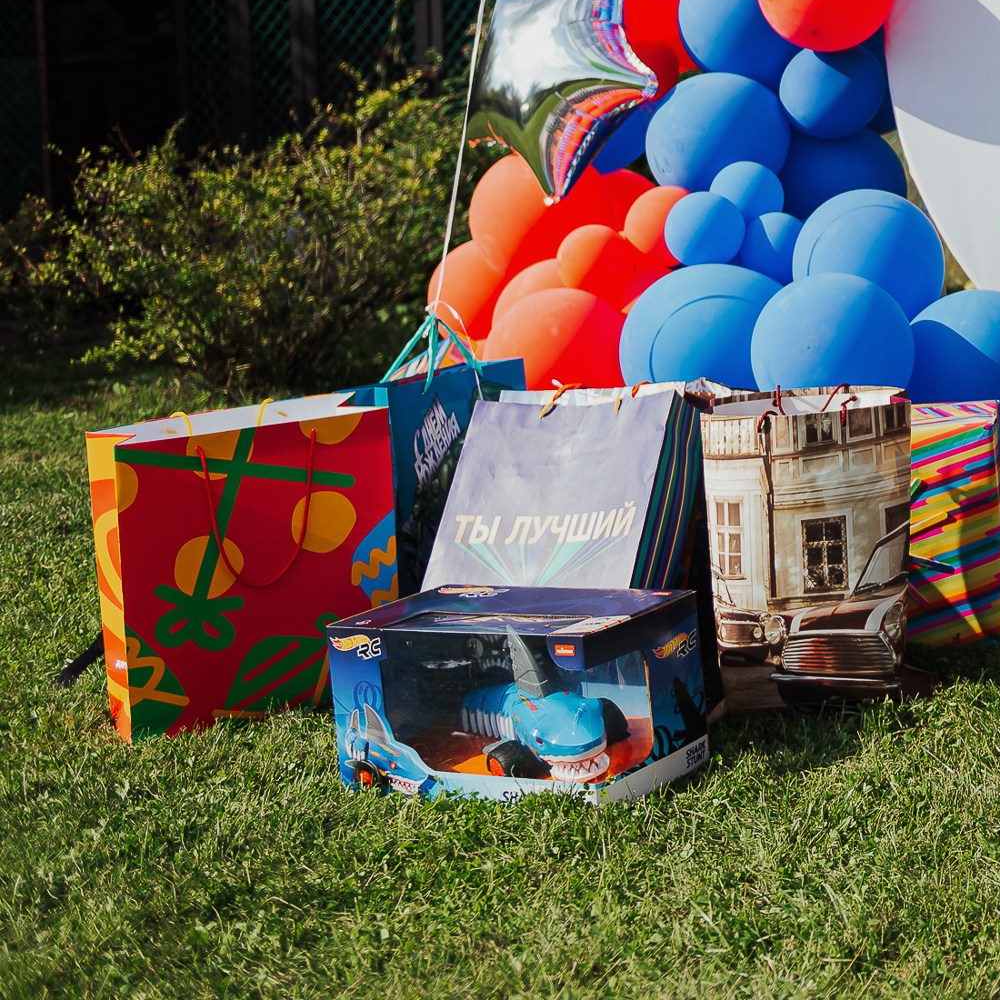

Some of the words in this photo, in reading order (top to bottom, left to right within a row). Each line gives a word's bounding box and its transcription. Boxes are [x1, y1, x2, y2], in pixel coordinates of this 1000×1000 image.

[454, 514, 503, 545] ТЫ
[504, 500, 637, 545] ЛУЧШИЙ
[357, 637, 382, 660] RC
[676, 628, 697, 657] RC
[686, 739, 706, 760] SHARK
[686, 750, 706, 769] STUNT
